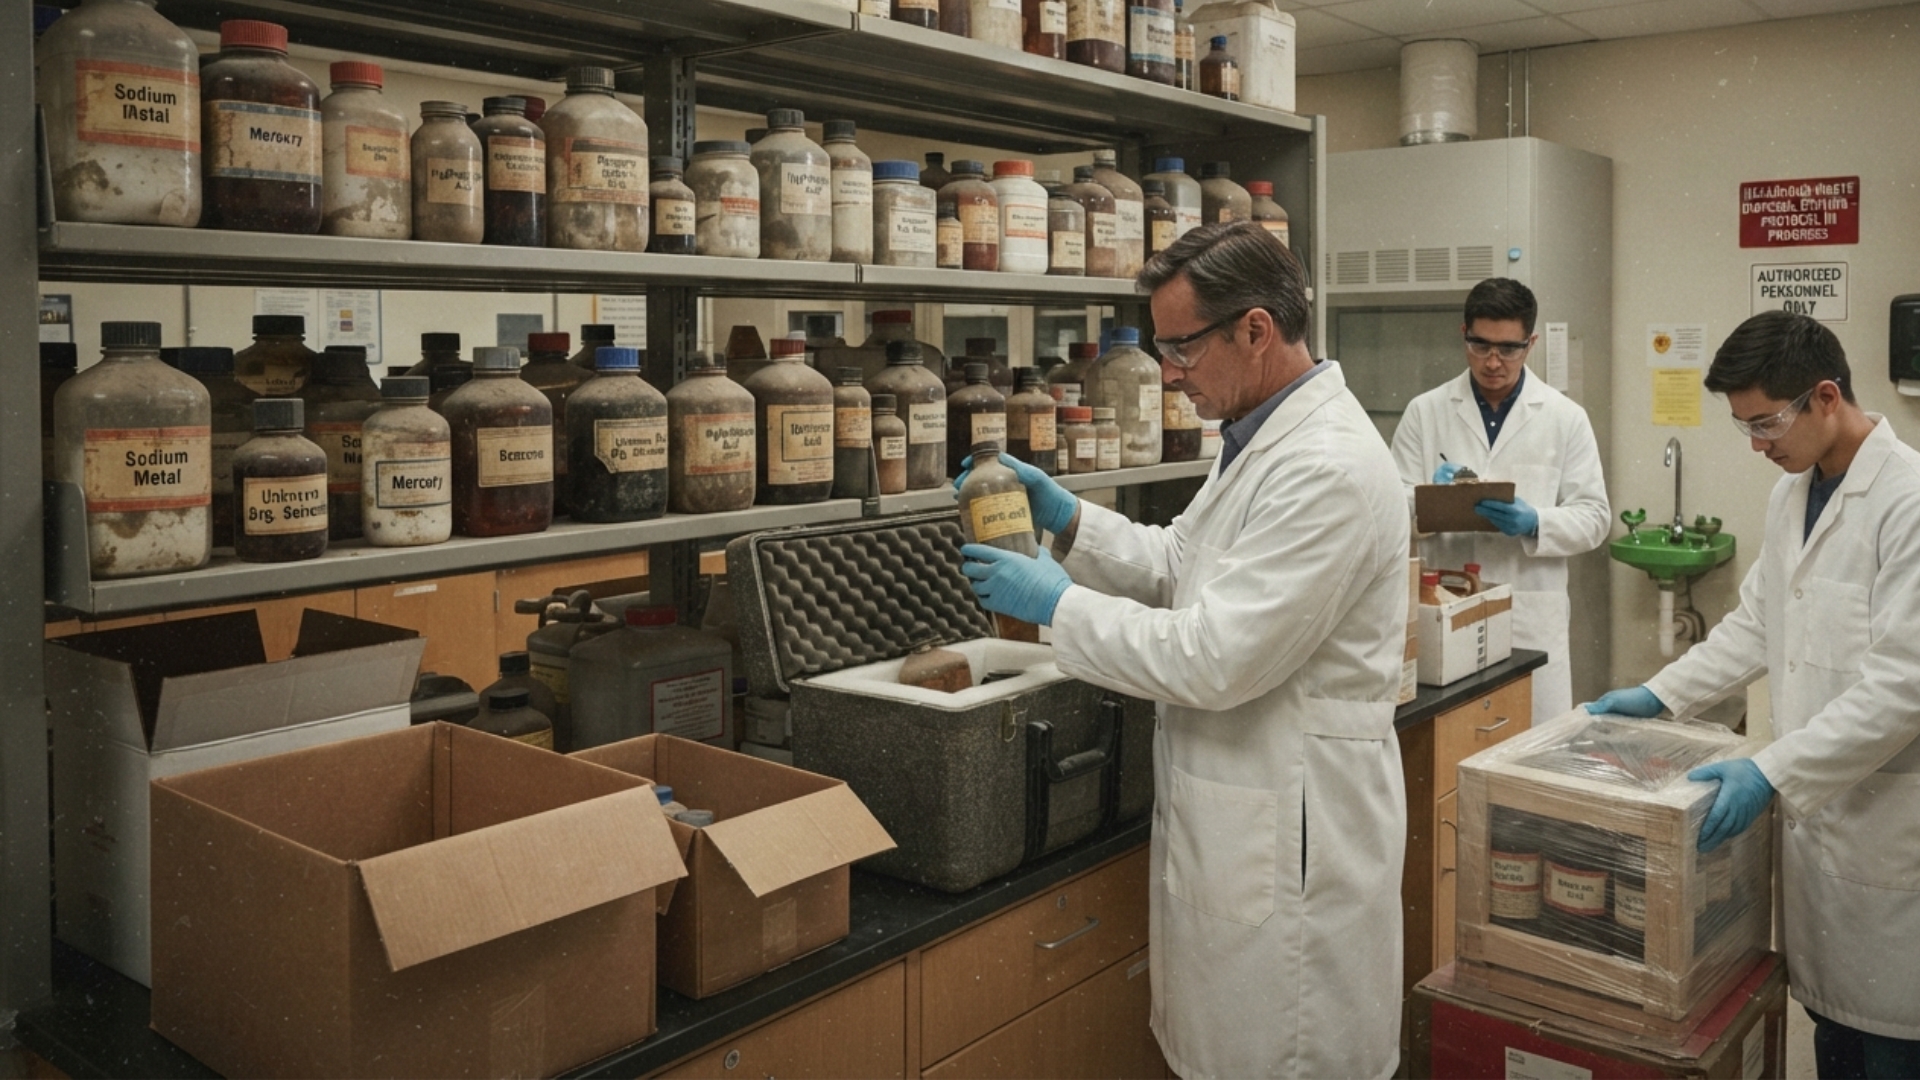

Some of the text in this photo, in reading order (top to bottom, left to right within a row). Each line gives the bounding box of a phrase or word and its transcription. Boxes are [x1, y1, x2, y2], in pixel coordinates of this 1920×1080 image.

[114, 83, 177, 105] Sodium
[125, 448, 188, 467] Sodium
[134, 468, 182, 487] Metal
